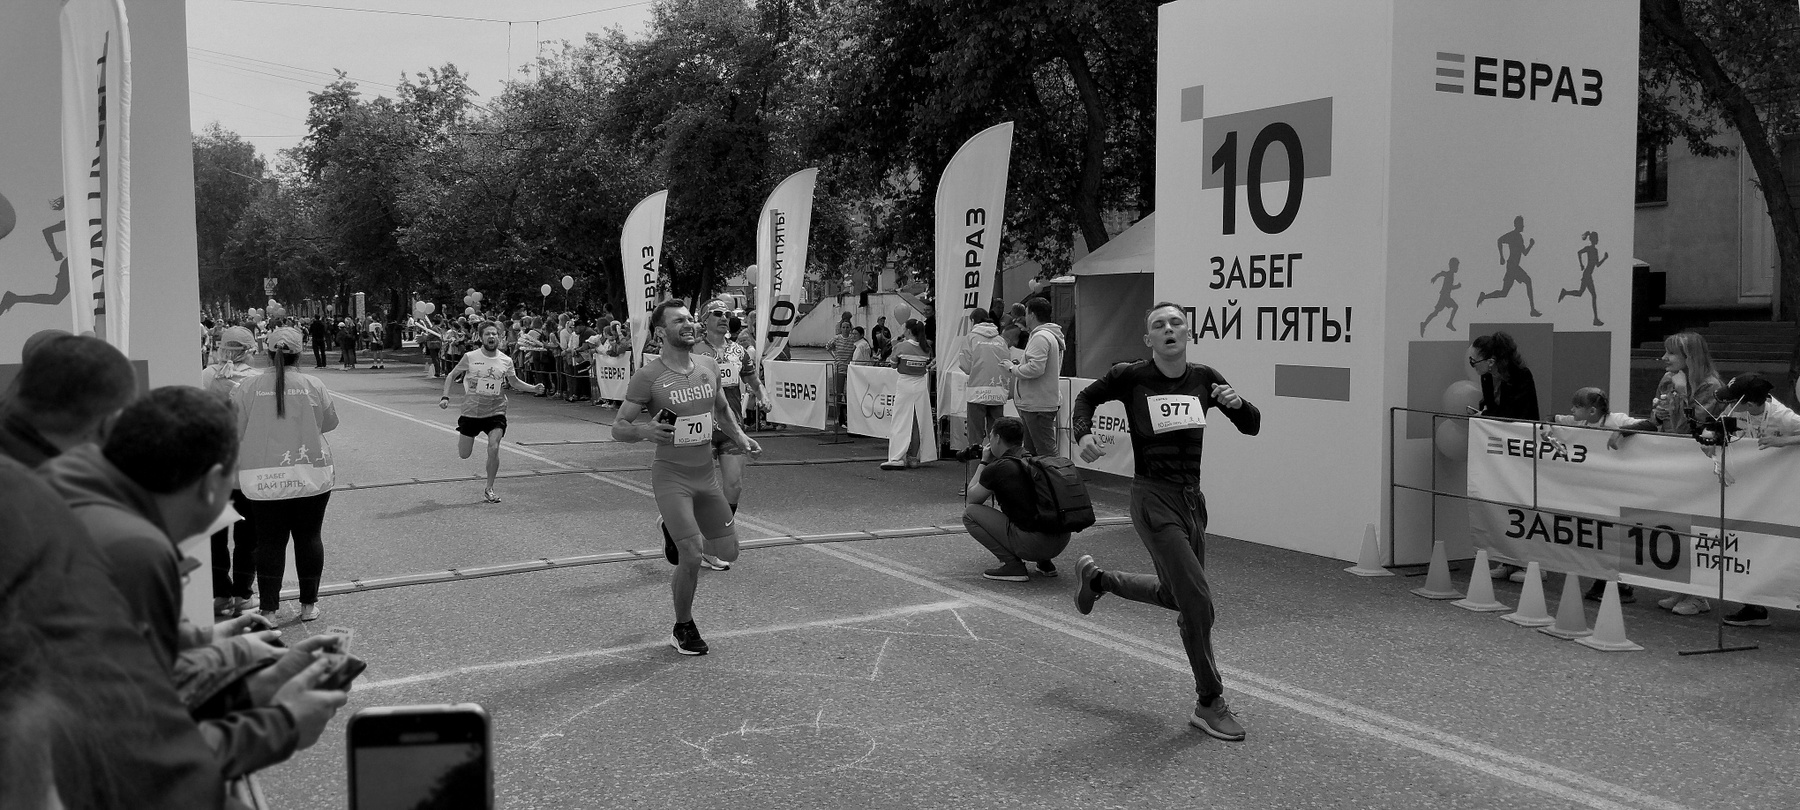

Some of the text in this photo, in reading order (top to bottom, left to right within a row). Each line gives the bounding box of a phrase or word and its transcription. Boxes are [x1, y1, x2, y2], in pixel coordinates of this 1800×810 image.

[1474, 56, 1603, 107] ЕВРАЗ
[1211, 122, 1305, 235] 10
[963, 207, 987, 310] ЕВРАЗ
[641, 245, 657, 313] ЕВРАЗ
[767, 212, 796, 343] 10 ДАЙ ПЯТЬ!
[1209, 252, 1303, 290] ЗАБЕГ
[1257, 306, 1352, 343] ПЯТЬ!
[604, 366, 626, 380] ЕВРАЗ
[669, 383, 714, 405] RUSSIA
[783, 381, 817, 401] ЕВРАЗ
[1160, 402, 1191, 418] 977
[687, 421, 703, 435] 70
[1098, 415, 1131, 433] ЕВРА
[1507, 438, 1588, 463] ЕВРАЗ
[257, 479, 306, 491] ДАЙ ПЯТЬ!
[264, 472, 286, 480] ЗАБЕГ
[1505, 508, 1681, 571] ЗАБЕГ 10
[1695, 532, 1738, 552] ДАЙ
[1696, 552, 1751, 575] ПЯТЬ!
